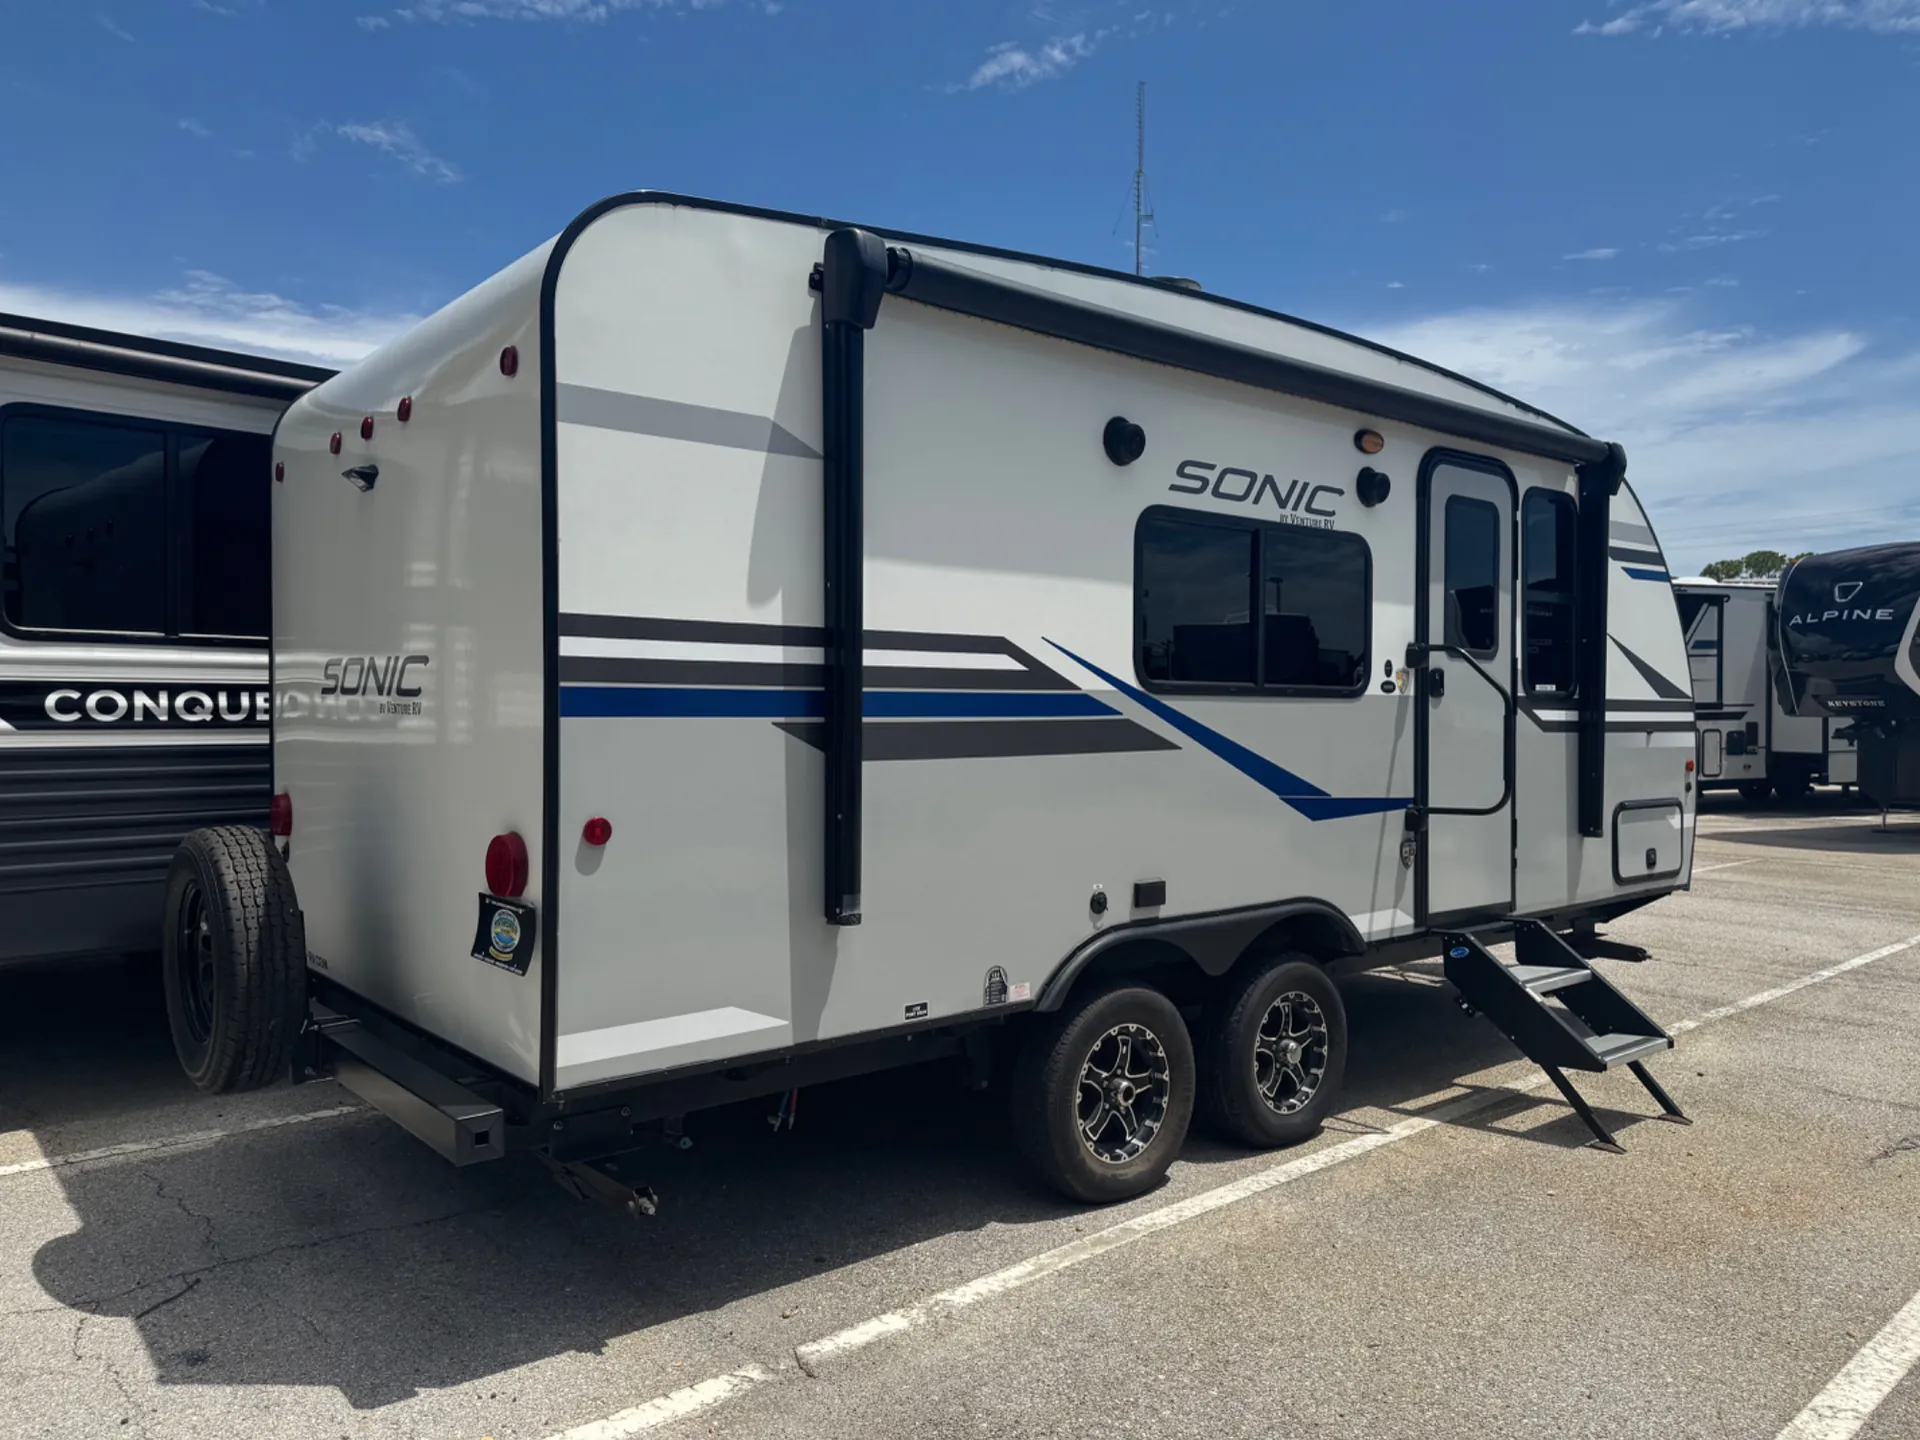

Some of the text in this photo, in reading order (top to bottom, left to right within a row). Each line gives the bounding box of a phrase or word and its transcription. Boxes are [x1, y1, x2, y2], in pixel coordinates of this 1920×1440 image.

[1168, 460, 1345, 517] SONIC
[1789, 609, 1894, 626] ALPINE
[321, 655, 430, 697] SONIC
[44, 689, 269, 722] CONQUE
